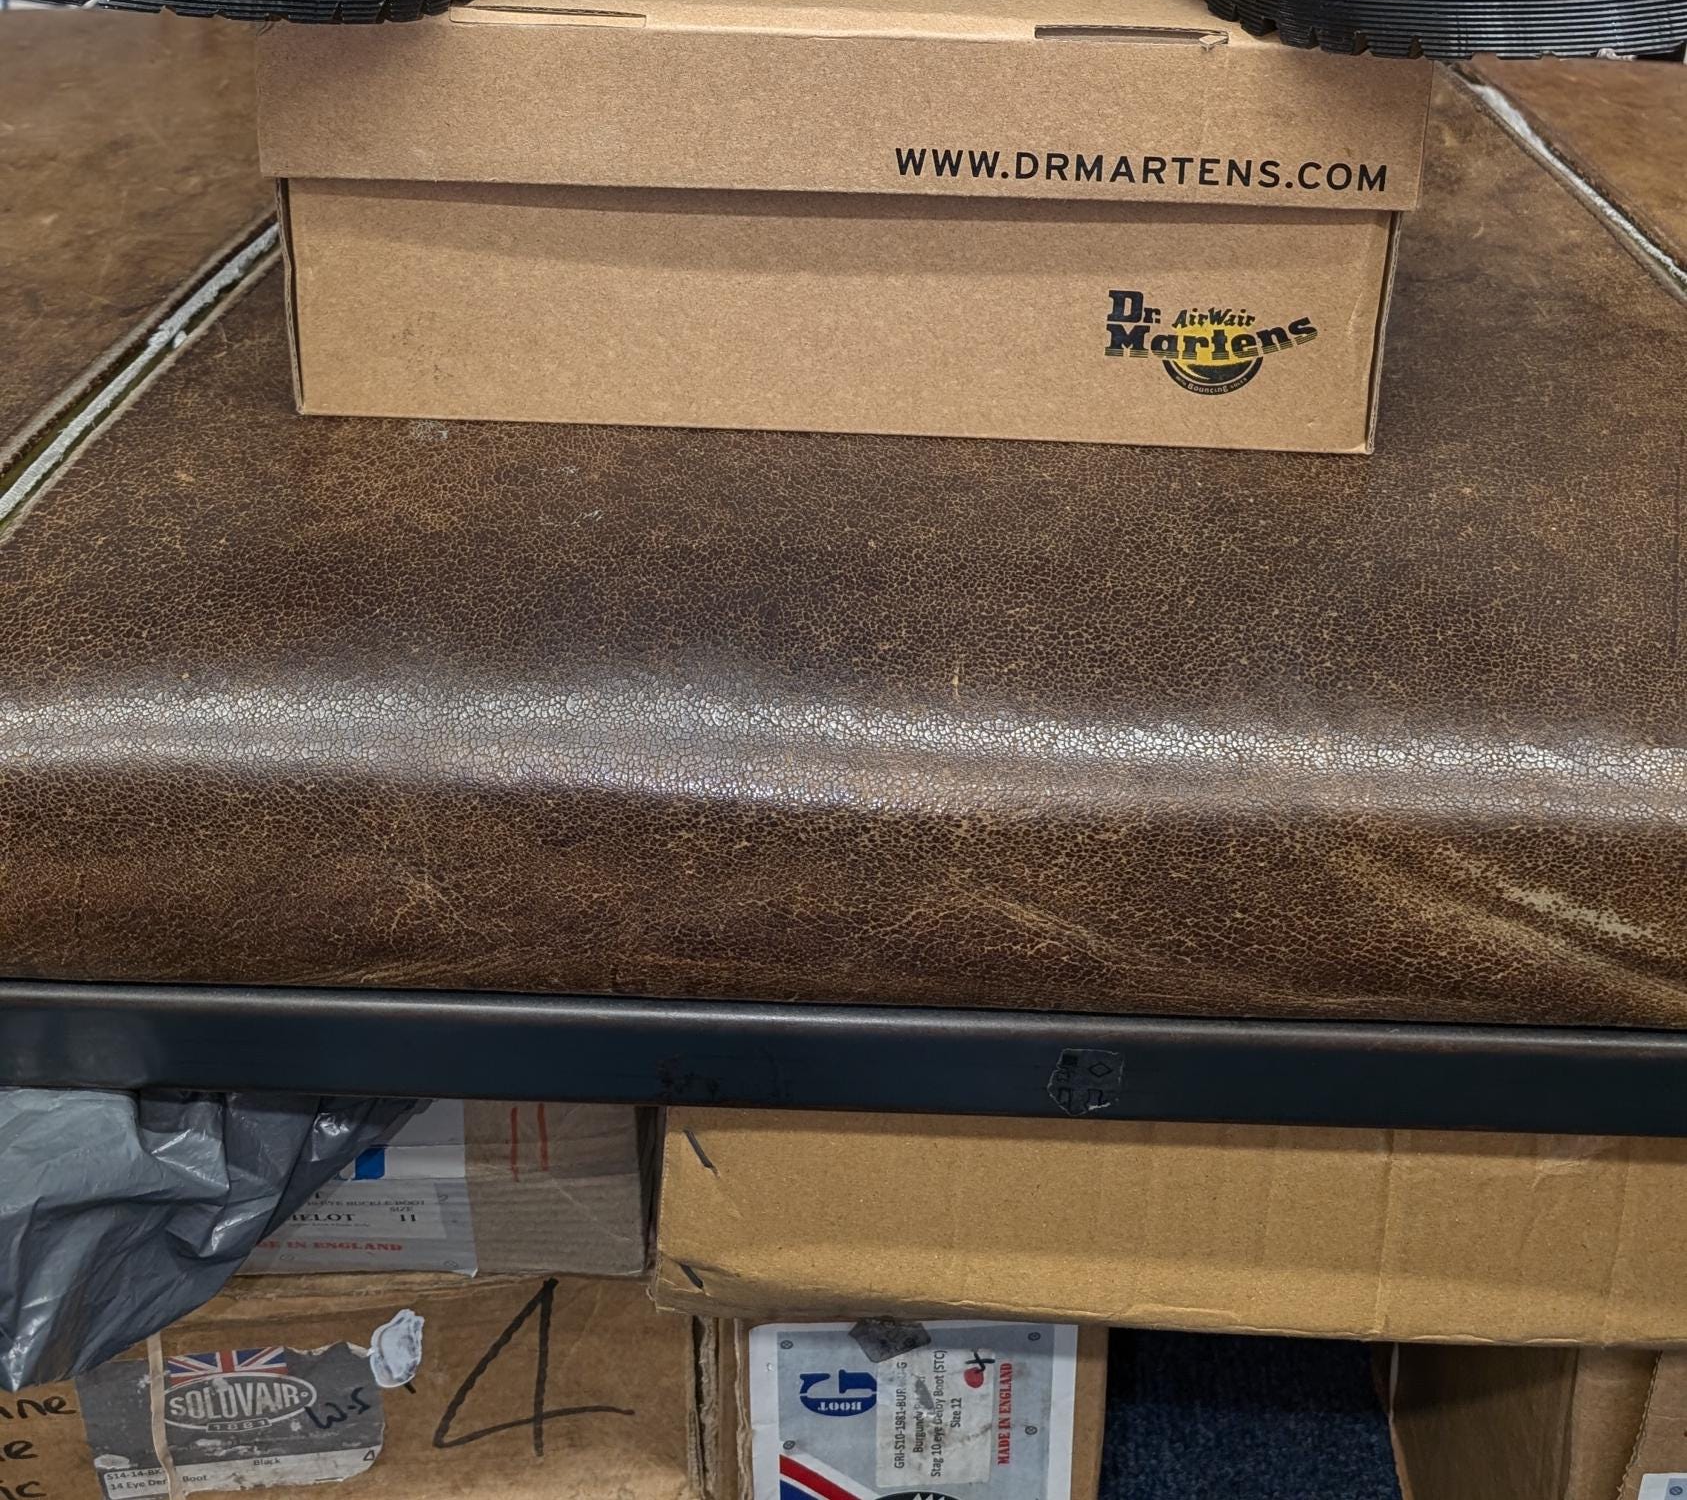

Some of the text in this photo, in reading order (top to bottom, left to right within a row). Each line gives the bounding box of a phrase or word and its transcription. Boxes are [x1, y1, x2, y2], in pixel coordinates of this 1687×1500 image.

[894, 147, 1389, 193] WWW.DRMARTENS.COM
[1106, 289, 1162, 325] Dr.
[1171, 306, 1257, 329] AirWair
[1104, 316, 1319, 361] Martens
[1187, 382, 1229, 394] Bouncing
[286, 1241, 307, 1249] IN
[313, 1241, 404, 1251] ENGLAND
[932, 1349, 947, 1373] (STC)
[168, 1381, 301, 1421] SOLOVAIR
[818, 1400, 863, 1412] BOOT
[950, 1397, 962, 1428] Size 12
[996, 1361, 1013, 1466] MADE IN ENGLAND
[931, 1443, 942, 1457] 10
[252, 1457, 281, 1467] Black
[930, 1457, 945, 1478] Stag
[110, 1482, 125, 1491] 14
[125, 1481, 146, 1490] Eye
[181, 1474, 208, 1483] Boot
